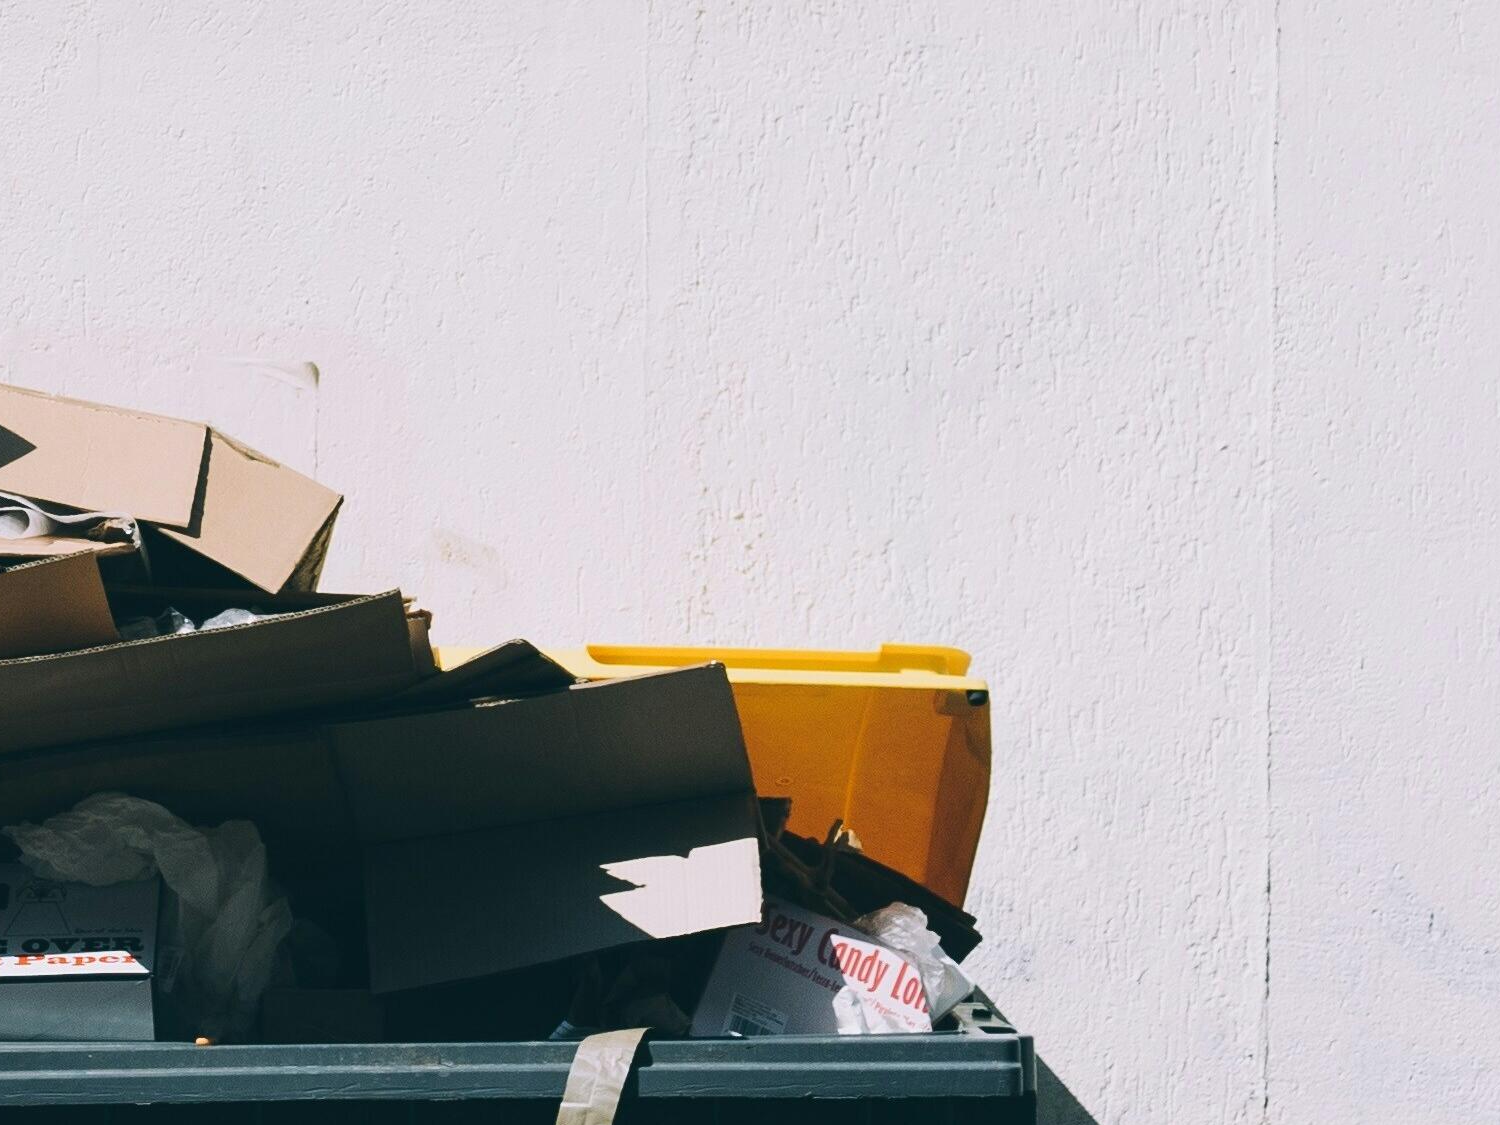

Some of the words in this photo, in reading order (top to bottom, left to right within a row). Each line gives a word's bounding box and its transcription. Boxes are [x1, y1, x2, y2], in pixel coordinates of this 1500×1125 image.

[20, 936, 145, 954] OVER
[14, 951, 143, 967] Paper
[817, 927, 889, 992] Candy
